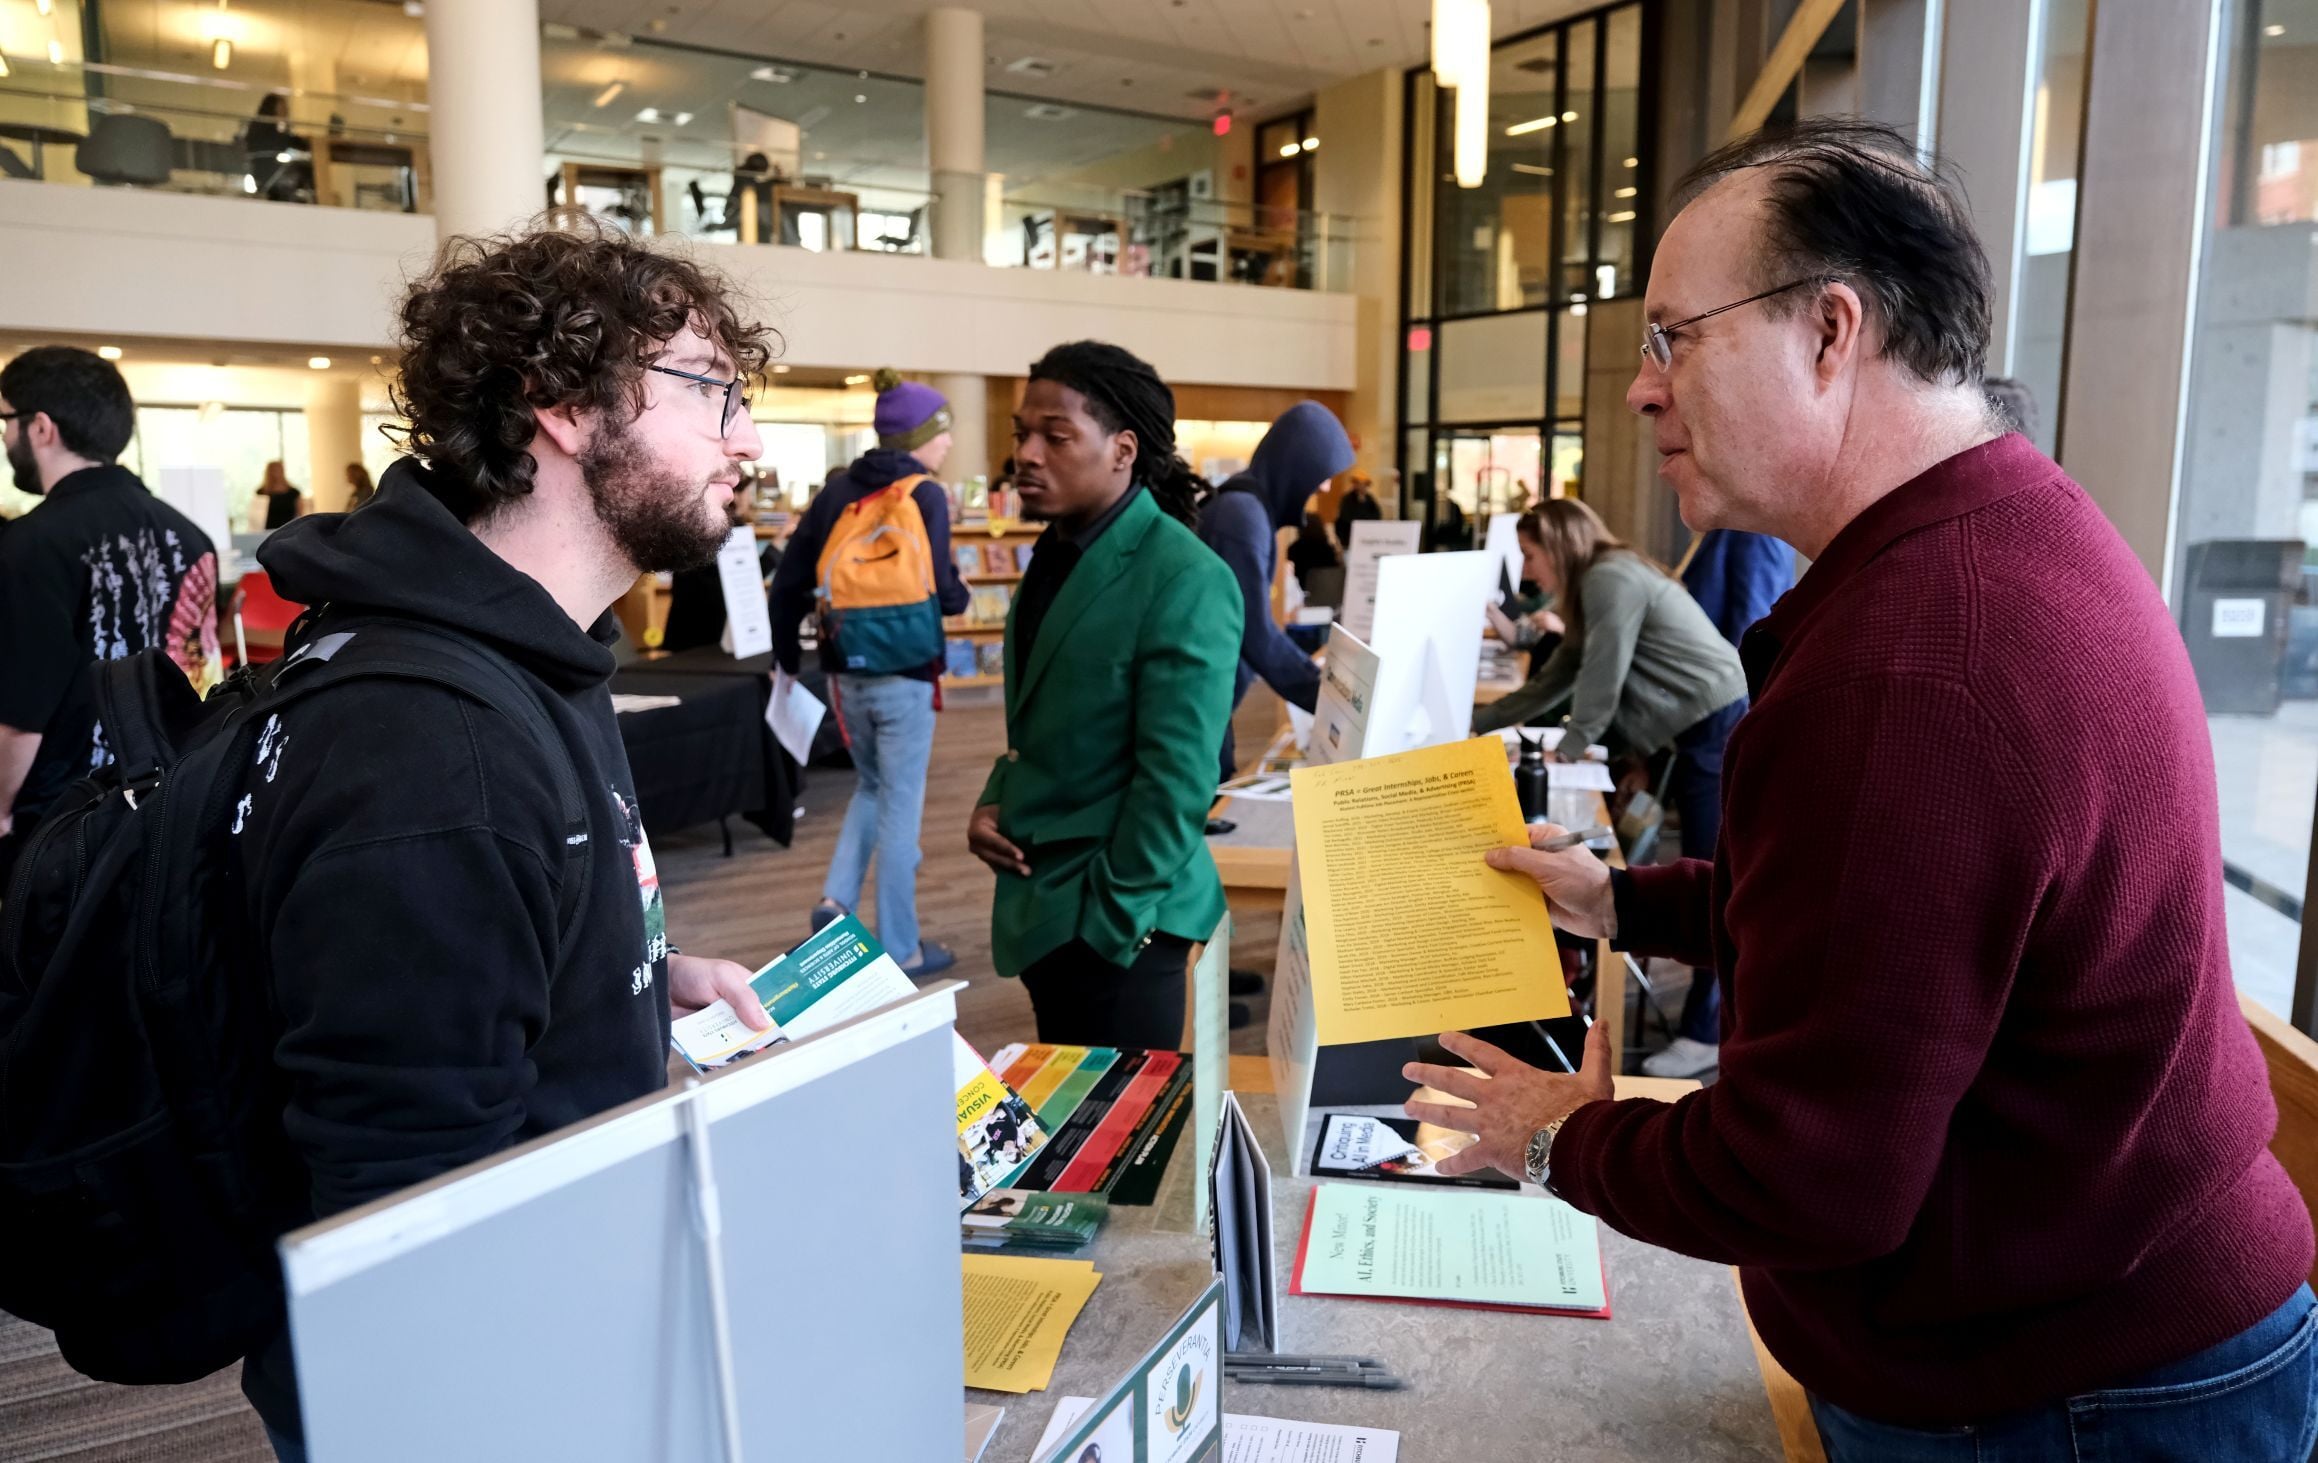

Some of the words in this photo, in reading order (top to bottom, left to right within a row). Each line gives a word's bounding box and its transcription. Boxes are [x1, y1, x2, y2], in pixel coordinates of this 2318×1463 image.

[1335, 788, 1354, 798] PRSA
[1362, 785, 1382, 794] Great
[1384, 780, 1423, 791] Internships,
[1425, 776, 1442, 785] Jobs,
[1450, 770, 1474, 780] Careers
[1426, 782, 1457, 793] Advertising
[808, 949, 853, 984] UNIVERSITY
[957, 1082, 985, 1107] CONCE
[1330, 1122, 1357, 1160] Critiquing
[1356, 1122, 1375, 1144] Media
[1352, 1153, 1368, 1162] AI
[1363, 1195, 1382, 1222] Society
[1362, 1224, 1376, 1238] and
[1330, 1240, 1346, 1260] New
[1358, 1240, 1374, 1266] Ethics,
[1357, 1268, 1372, 1282] AI,
[1155, 1333, 1212, 1415] PERSEVERANTIA
